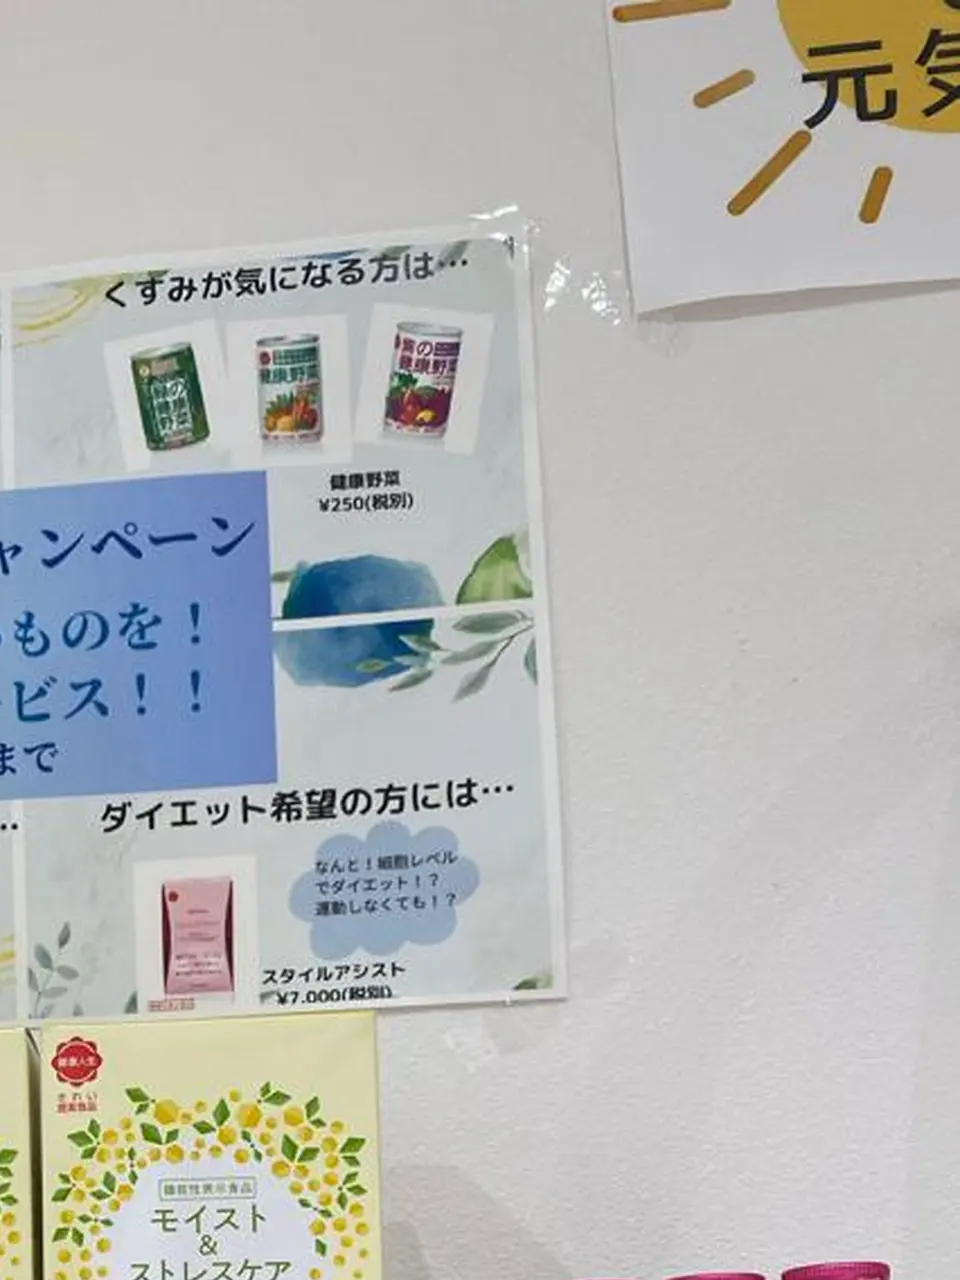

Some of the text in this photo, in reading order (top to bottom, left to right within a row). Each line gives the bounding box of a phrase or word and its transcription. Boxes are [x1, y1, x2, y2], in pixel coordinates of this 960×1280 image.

[105, 253, 469, 308] くすみが気になる方は…
[330, 471, 400, 491] 健康野菜
[319, 492, 414, 513] ¥250(税別)
[100, 779, 515, 833] ダイエット希望の方には…
[262, 962, 406, 985] スタイルアシスト
[152, 1204, 266, 1233] モイスト
[199, 1235, 219, 1256] &
